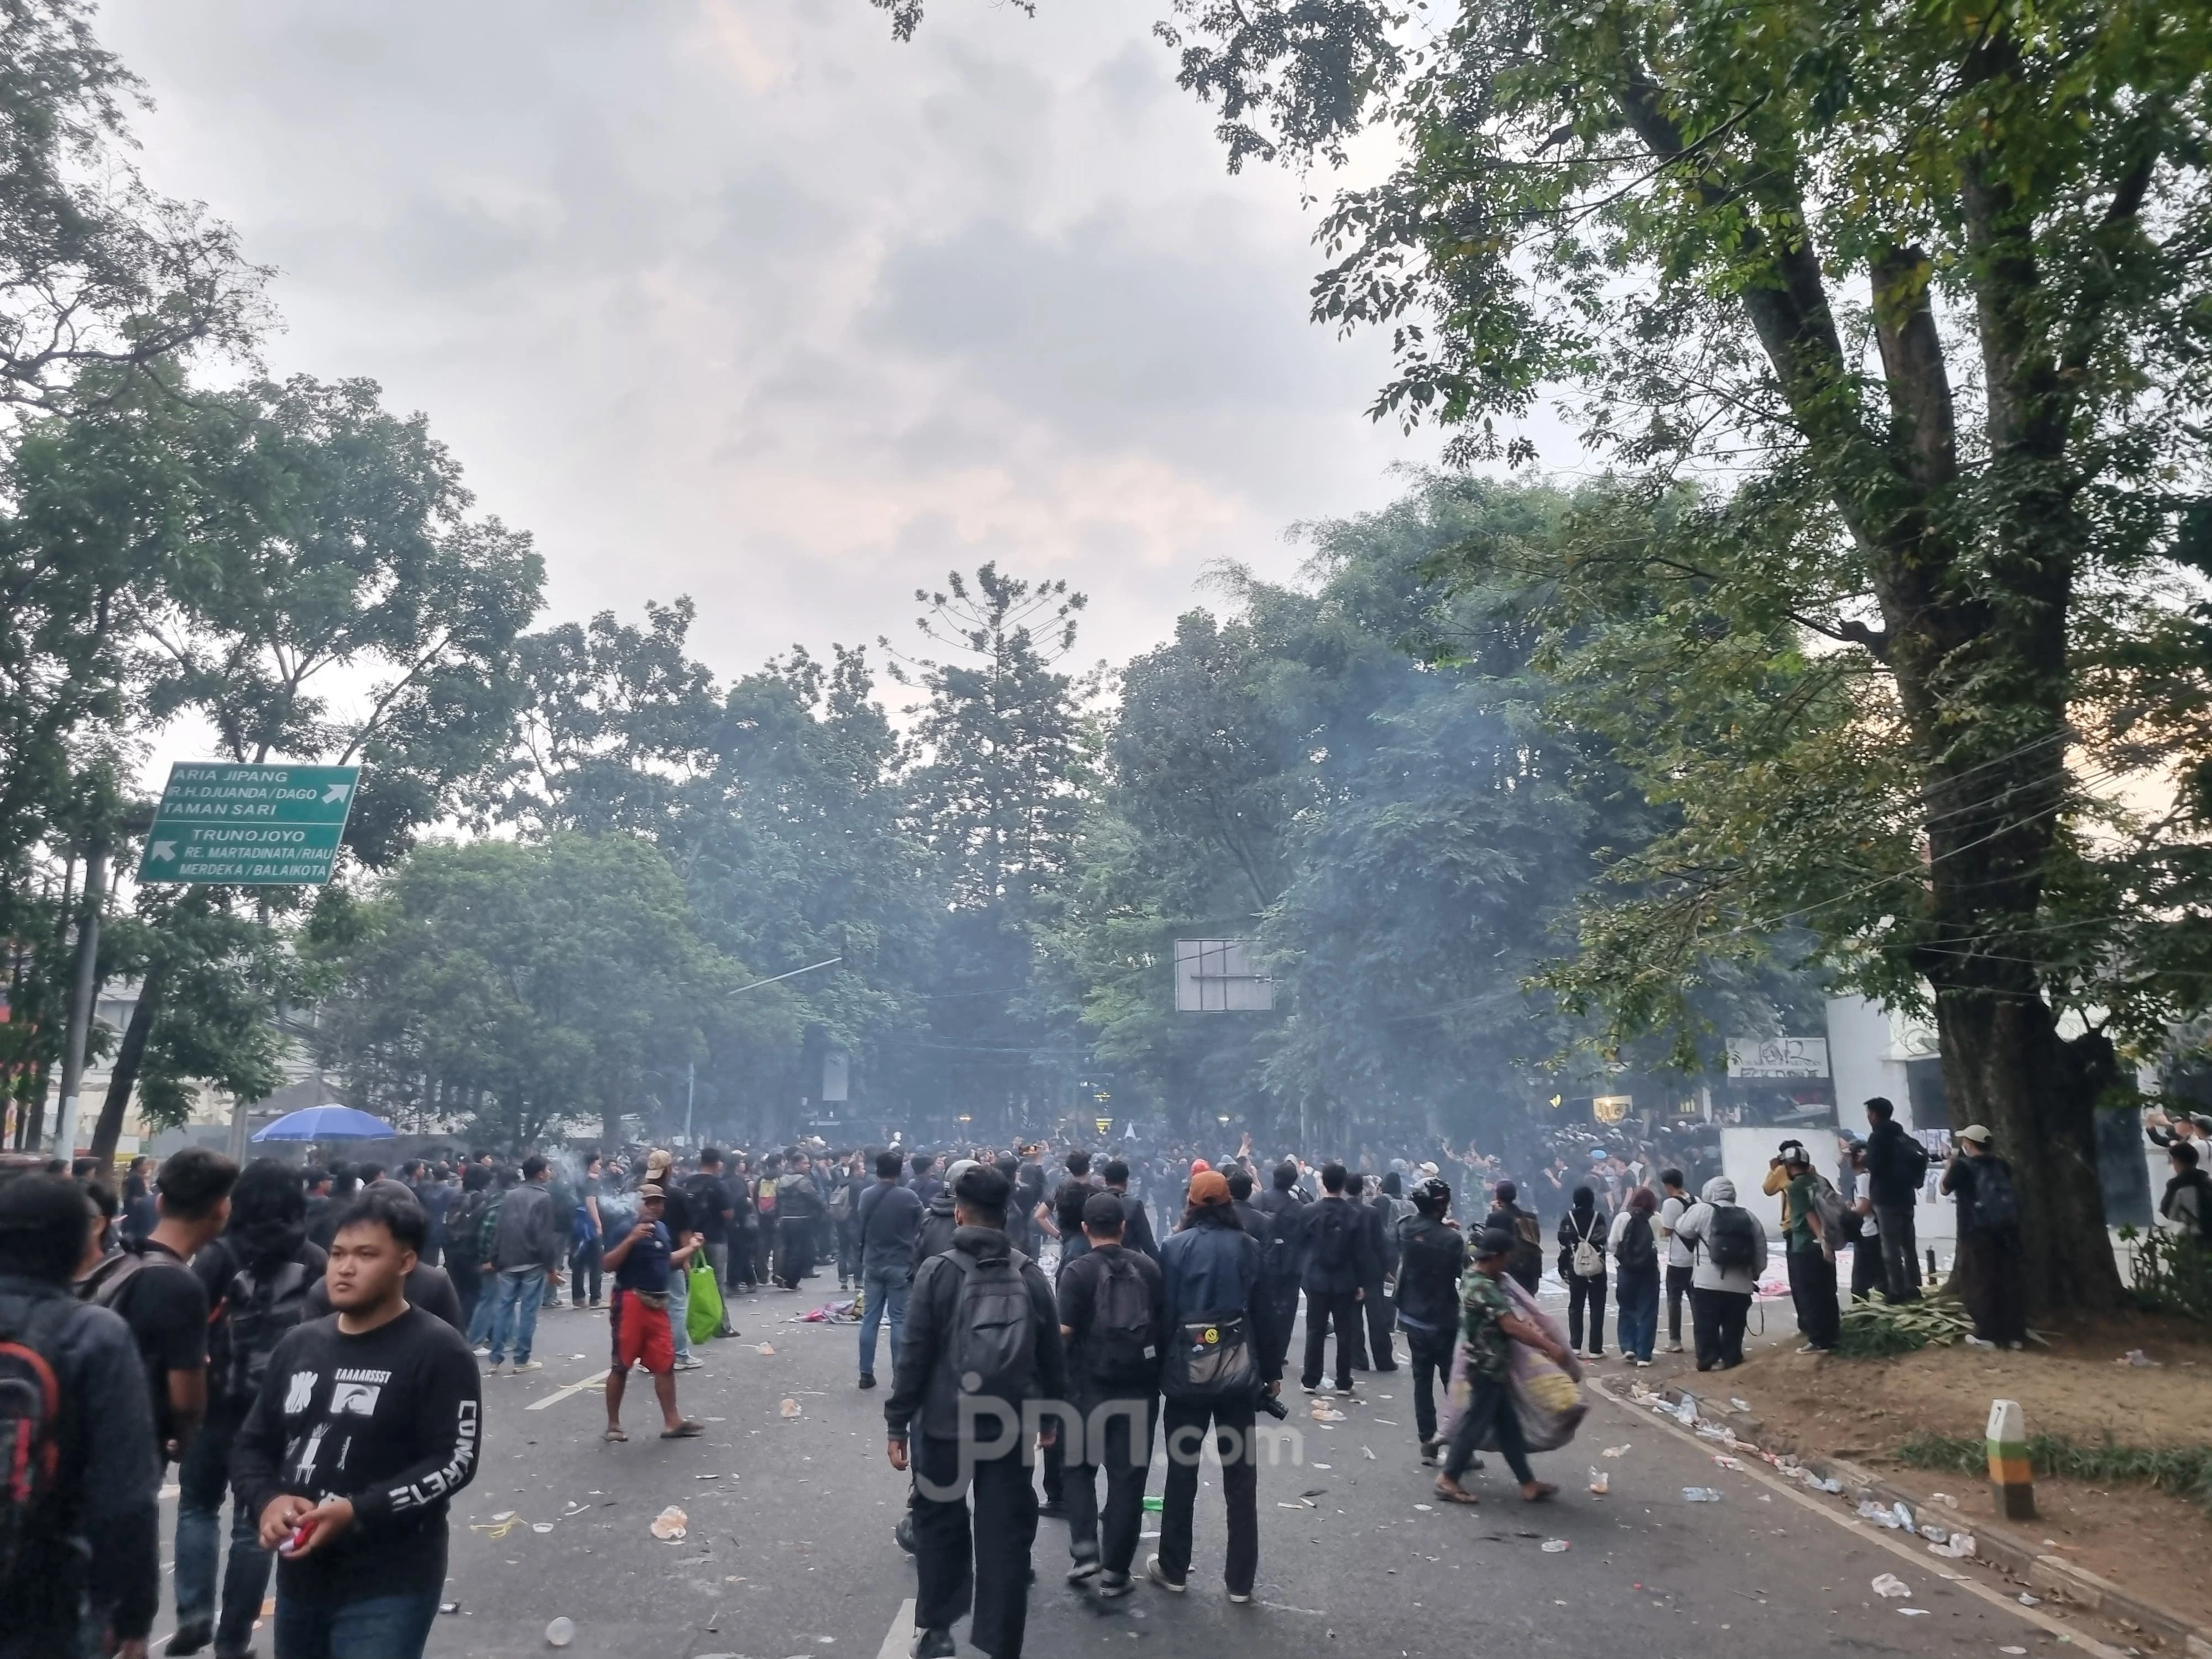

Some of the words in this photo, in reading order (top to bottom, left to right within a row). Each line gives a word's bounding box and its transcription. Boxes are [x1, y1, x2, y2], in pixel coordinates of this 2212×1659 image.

[173, 769, 217, 781] ARIA
[223, 770, 288, 782] JIPANG
[163, 803, 228, 815] TAMAN
[231, 804, 277, 816] SARI
[192, 830, 305, 842] TRUNOJOYO
